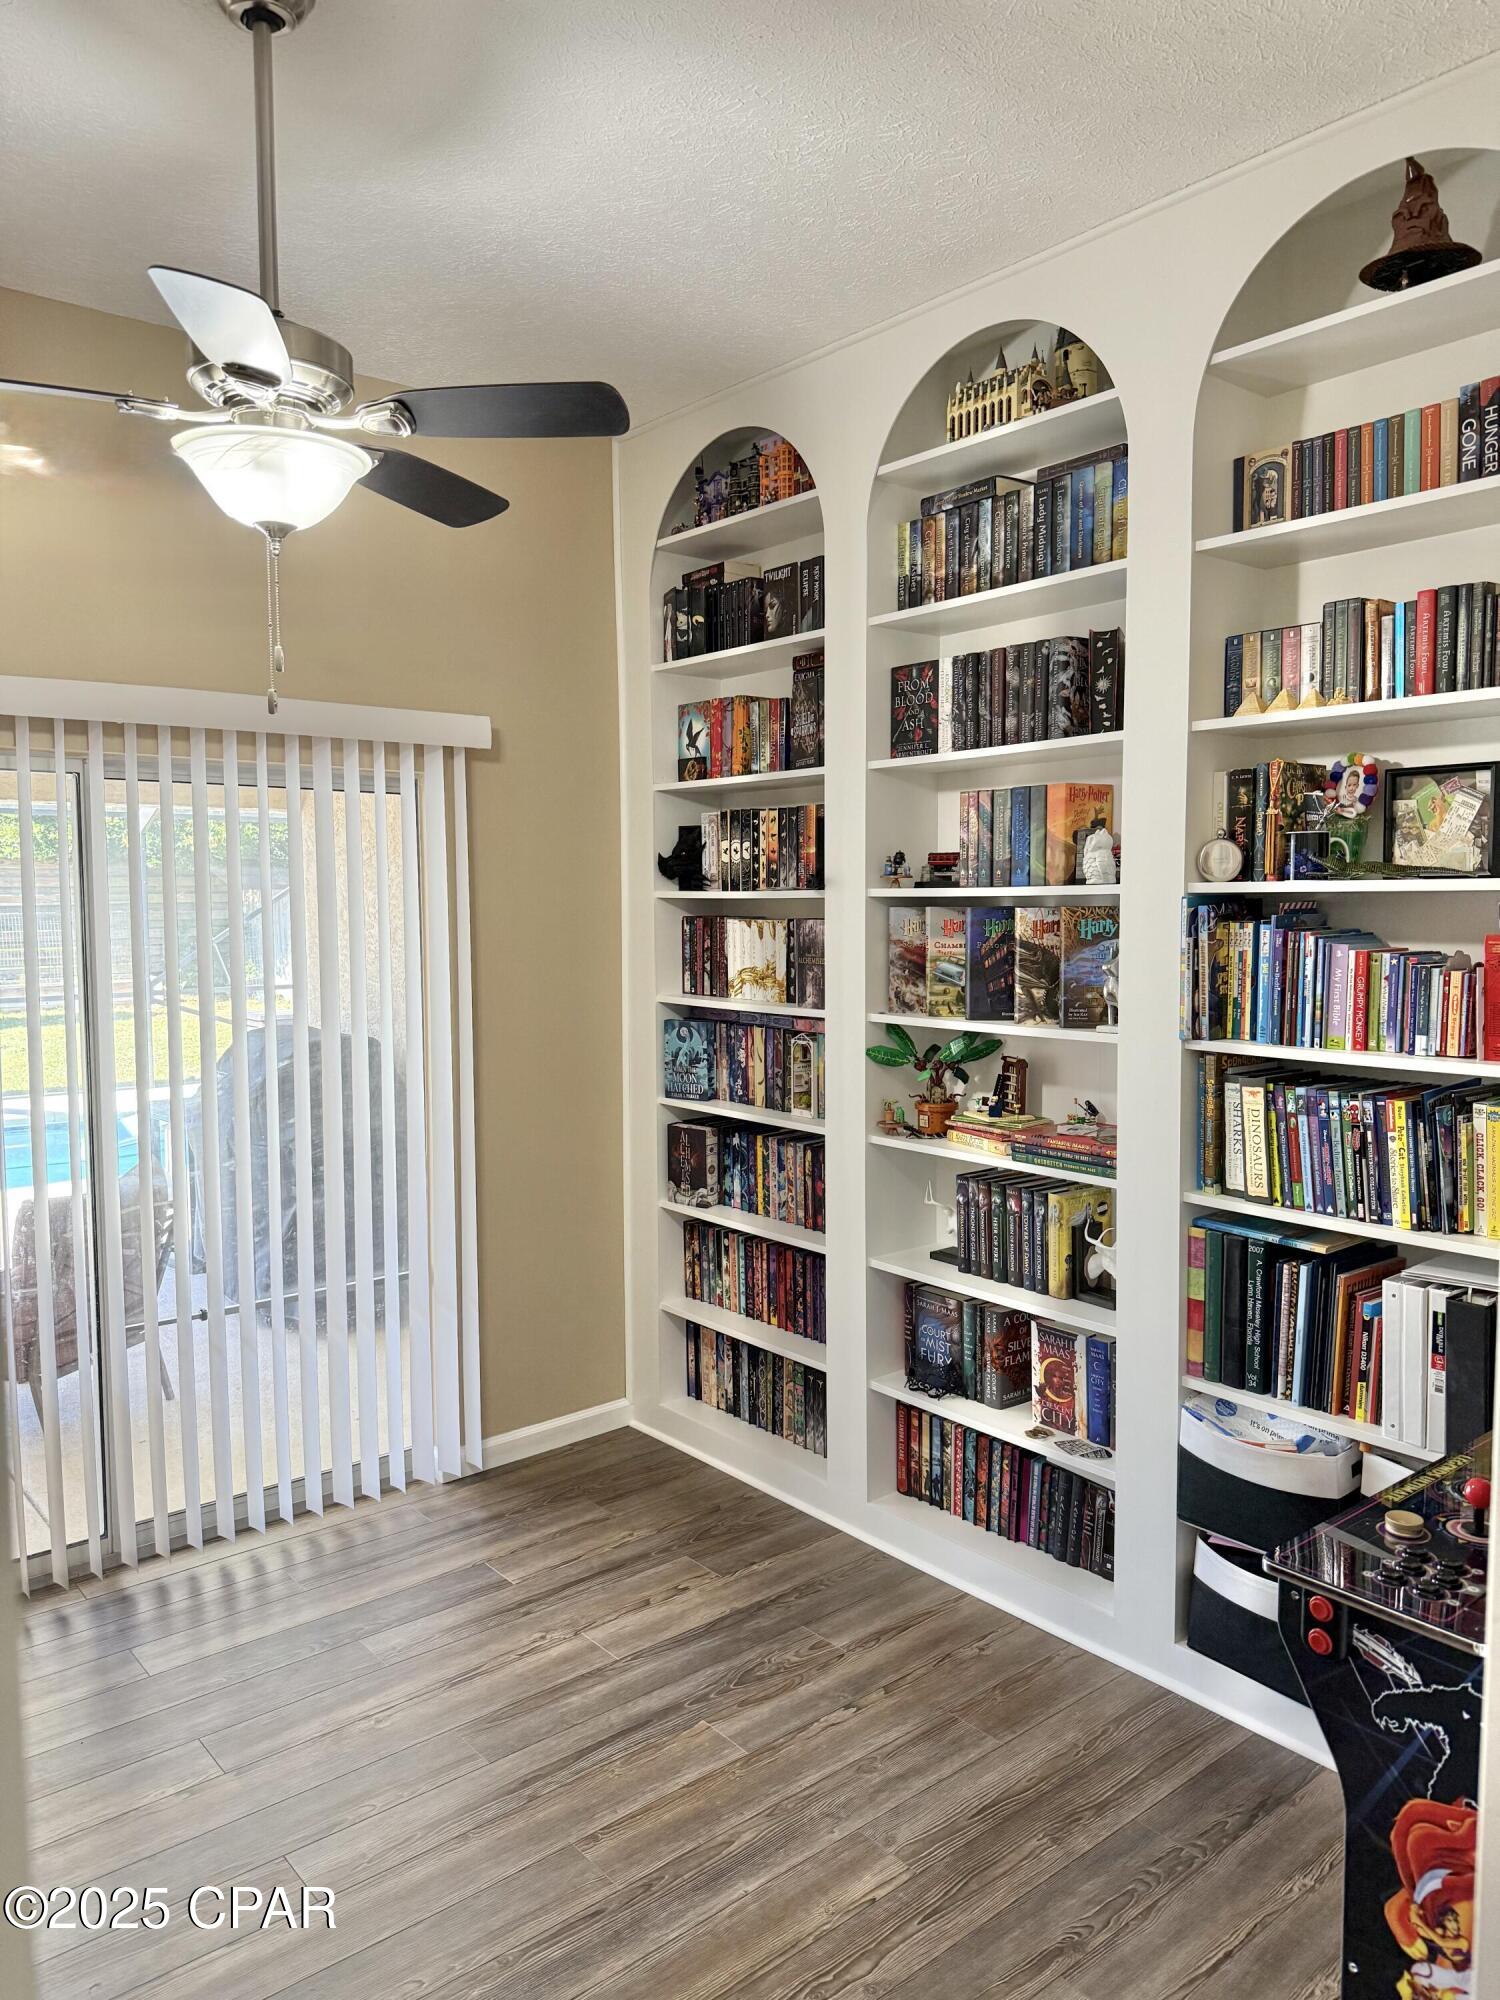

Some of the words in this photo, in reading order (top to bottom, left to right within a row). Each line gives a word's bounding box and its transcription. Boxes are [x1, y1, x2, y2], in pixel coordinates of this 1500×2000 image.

[1462, 418, 1477, 472] GONE
[1484, 405, 1498, 475] HUNGER
[1037, 495, 1047, 524] Lady
[1057, 489, 1065, 513] Lord
[1037, 525, 1047, 572] Midnight
[1056, 523, 1064, 566] Shadows
[765, 567, 792, 583] TWILIGHT
[1421, 612, 1430, 649] ARTEMIS
[1442, 610, 1451, 647] ARTEMIS
[1421, 652, 1429, 674] FOWL
[1442, 650, 1450, 674] FOWL
[898, 679, 929, 693] FROM
[895, 692, 933, 708] BLOOD
[908, 708, 919, 716] AND
[902, 718, 924, 731] ASH
[1069, 786, 1088, 802] Harry
[1088, 785, 1109, 804] Potter
[1235, 816, 1246, 846] NAR
[900, 918, 926, 937] Har
[941, 918, 966, 938] Har
[1078, 918, 1118, 940] Harry
[934, 941, 966, 949] CHAMB
[1334, 968, 1342, 981] My
[1333, 983, 1342, 1002] First
[1356, 976, 1364, 1009] GRUMPY
[1332, 1005, 1342, 1026] Bible
[1355, 1010, 1364, 1043] MONKEY
[673, 1072, 697, 1083] MOON
[668, 1083, 704, 1095] HATCHED
[1232, 1102, 1242, 1155] SHARKS
[1249, 1109, 1264, 1189] DINOSAURS
[1398, 1147, 1406, 1160] Cat
[1475, 1132, 1485, 1161] CLICK,
[1389, 1148, 1398, 1177] Stories
[1335, 1170, 1343, 1200] Favorites
[1475, 1163, 1485, 1196] CLACK,
[1392, 1186, 1400, 1209] Share
[1476, 1197, 1485, 1212] GO!
[993, 1235, 999, 1245] OF
[1024, 1242, 1029, 1251] OF
[1248, 1246, 1264, 1254] 2007
[1247, 1280, 1255, 1297] Lynn
[1255, 1268, 1263, 1300] Crawford
[917, 1300, 934, 1310] SARAH
[941, 1308, 958, 1318] MAAS
[1004, 1317, 1010, 1327] A
[1014, 1313, 1031, 1324] COU
[922, 1324, 951, 1341] COURT
[1040, 1332, 1067, 1349] SARAH
[1253, 1329, 1261, 1345] High
[925, 1338, 951, 1354] MIST
[1008, 1337, 1031, 1353] SILVE
[1043, 1343, 1071, 1360] MAAS
[920, 1347, 952, 1367] FURY
[1004, 1352, 1031, 1367] FLAM
[1253, 1346, 1261, 1369] School
[1360, 1351, 1368, 1371] D3400
[1090, 1376, 1104, 1386] CITY
[1247, 1379, 1257, 1388] 34
[1041, 1400, 1073, 1416] CRESCENT
[1042, 1407, 1073, 1429] CITY
[1250, 1419, 1261, 1430] It's
[1261, 1425, 1269, 1433] on
[1269, 1429, 1288, 1440] prim
